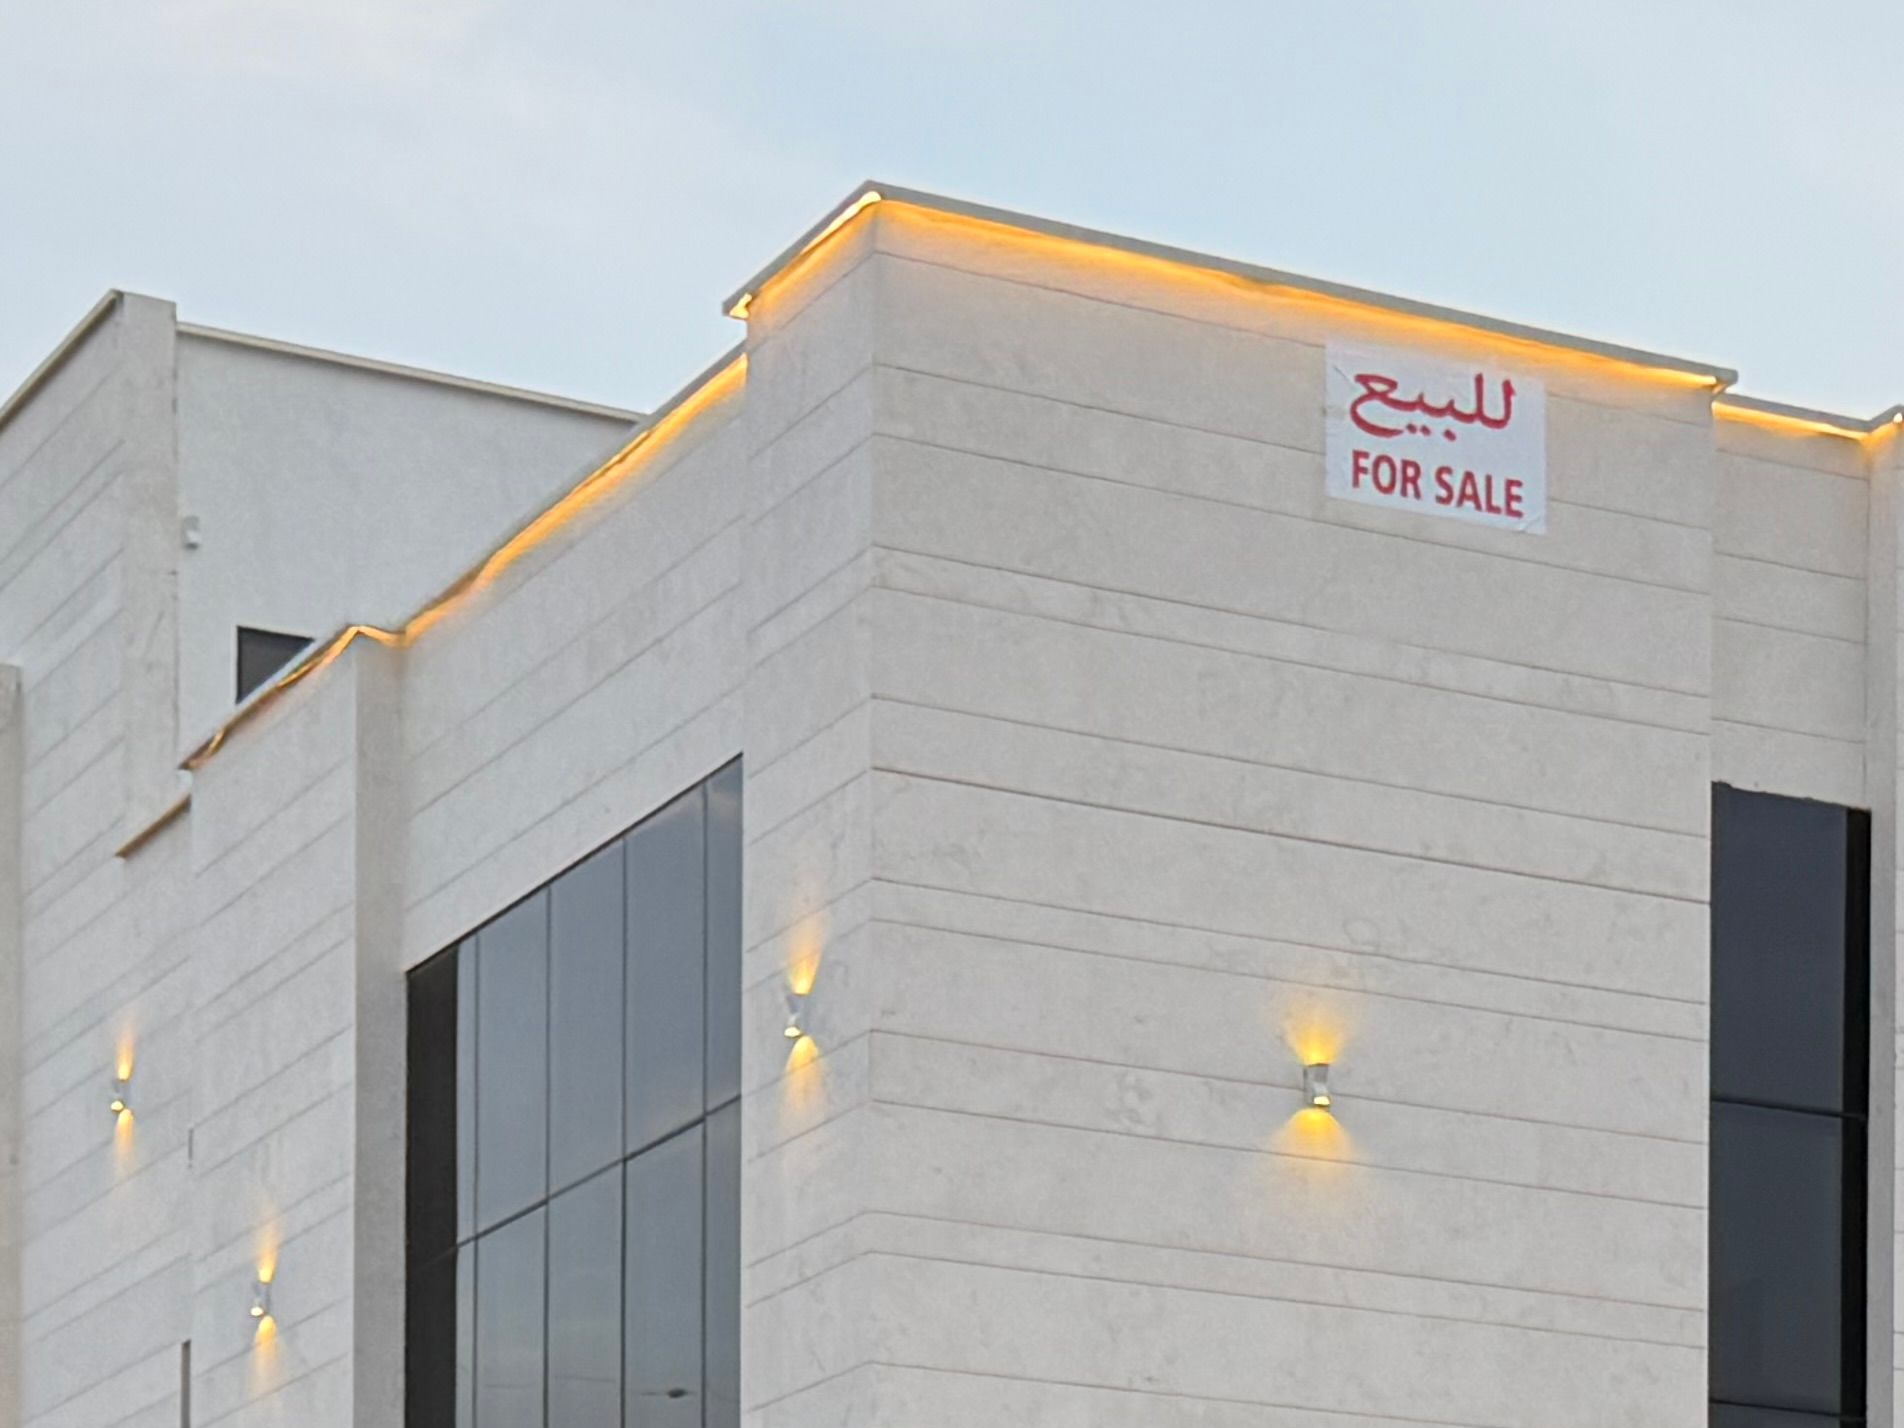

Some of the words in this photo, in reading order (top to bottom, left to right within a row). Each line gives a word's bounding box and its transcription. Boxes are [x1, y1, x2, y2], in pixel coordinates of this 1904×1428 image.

[1350, 373, 1516, 441] للبيع
[1352, 450, 1422, 499] FOR
[1435, 466, 1524, 518] SALE
